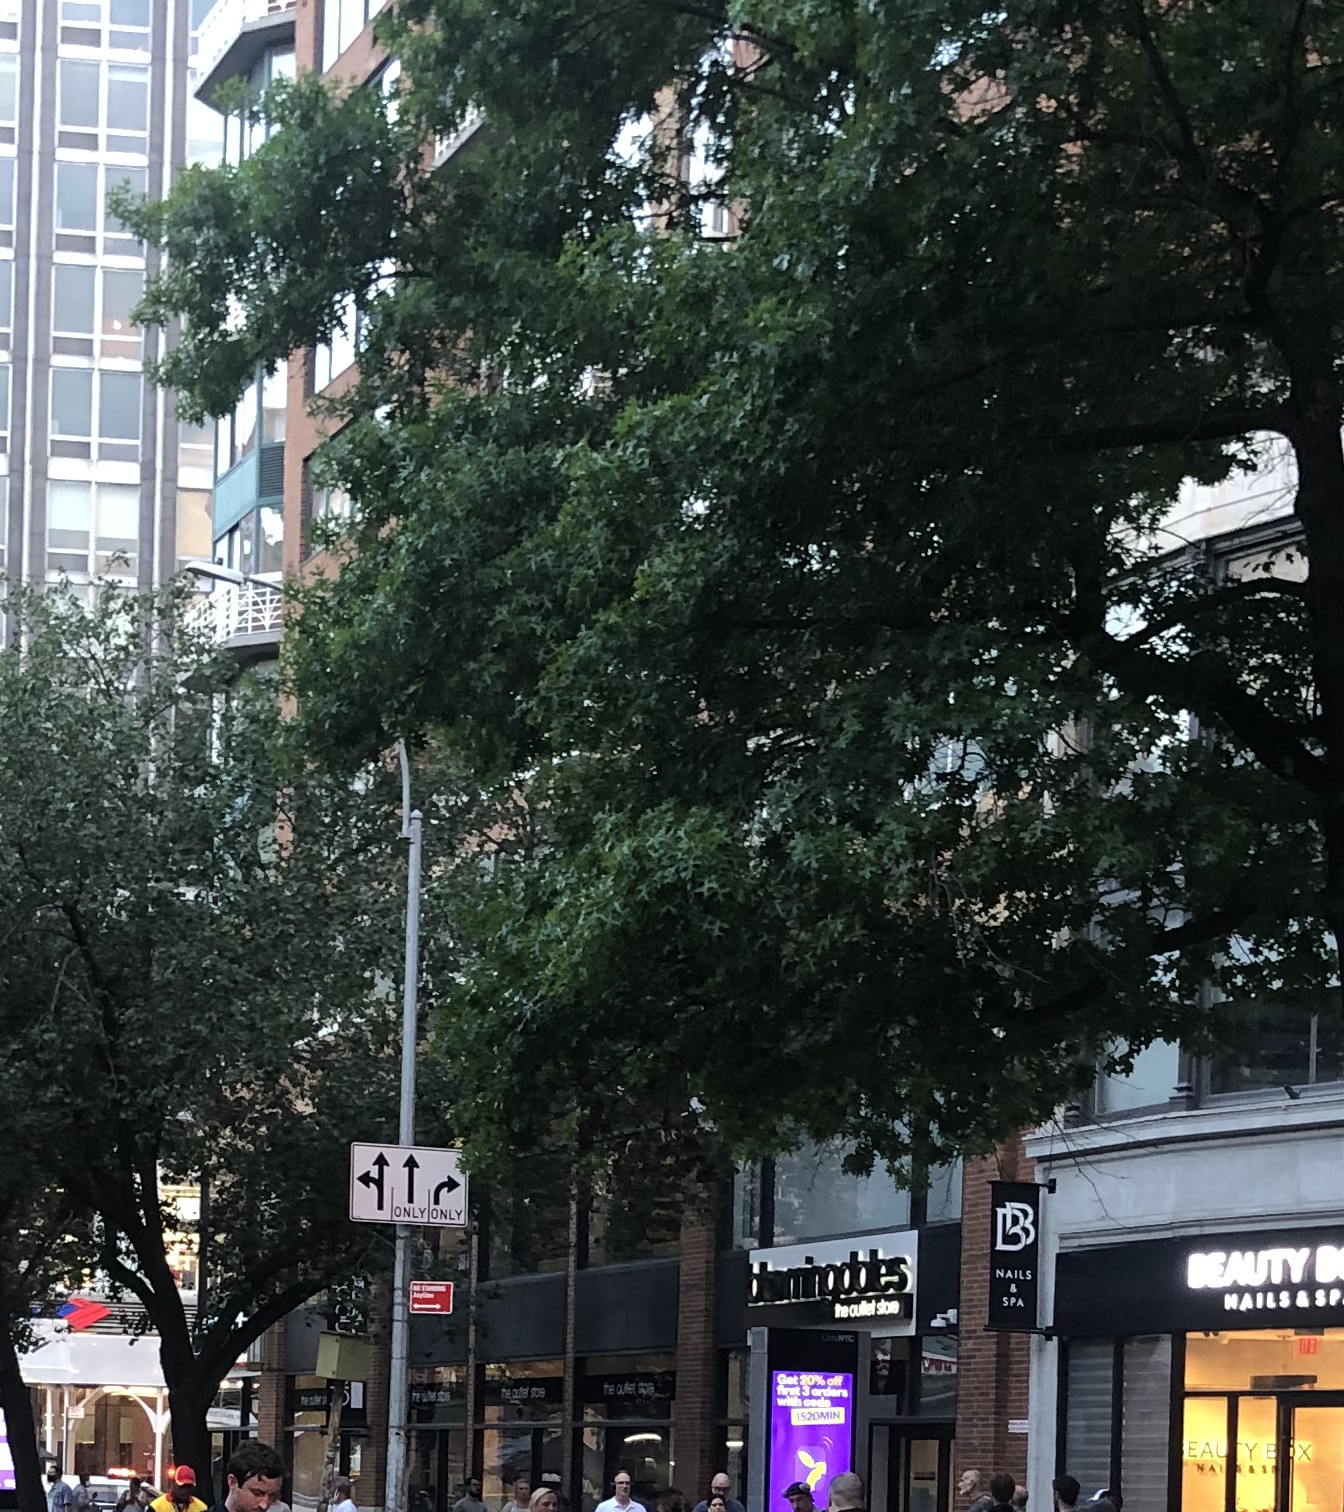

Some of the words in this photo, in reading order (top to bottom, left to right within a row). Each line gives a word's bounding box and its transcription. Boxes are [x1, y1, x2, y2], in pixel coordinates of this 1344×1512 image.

[394, 1206, 426, 1219] ONLY
[431, 1208, 463, 1220] ONLY
[996, 1268, 1032, 1280] NAILS
[1187, 1247, 1310, 1289] BEAUTY
[1009, 1283, 1017, 1293] &
[1002, 1296, 1025, 1308] SPA
[1224, 1290, 1291, 1312] NAILS
[1295, 1290, 1310, 1308] &
[835, 1302, 849, 1319] the
[849, 1300, 876, 1317] outlet
[876, 1299, 900, 1316] store
[826, 1374, 844, 1386] off
[811, 1386, 848, 1398] orders
[797, 1410, 840, 1422] 1520MIN
